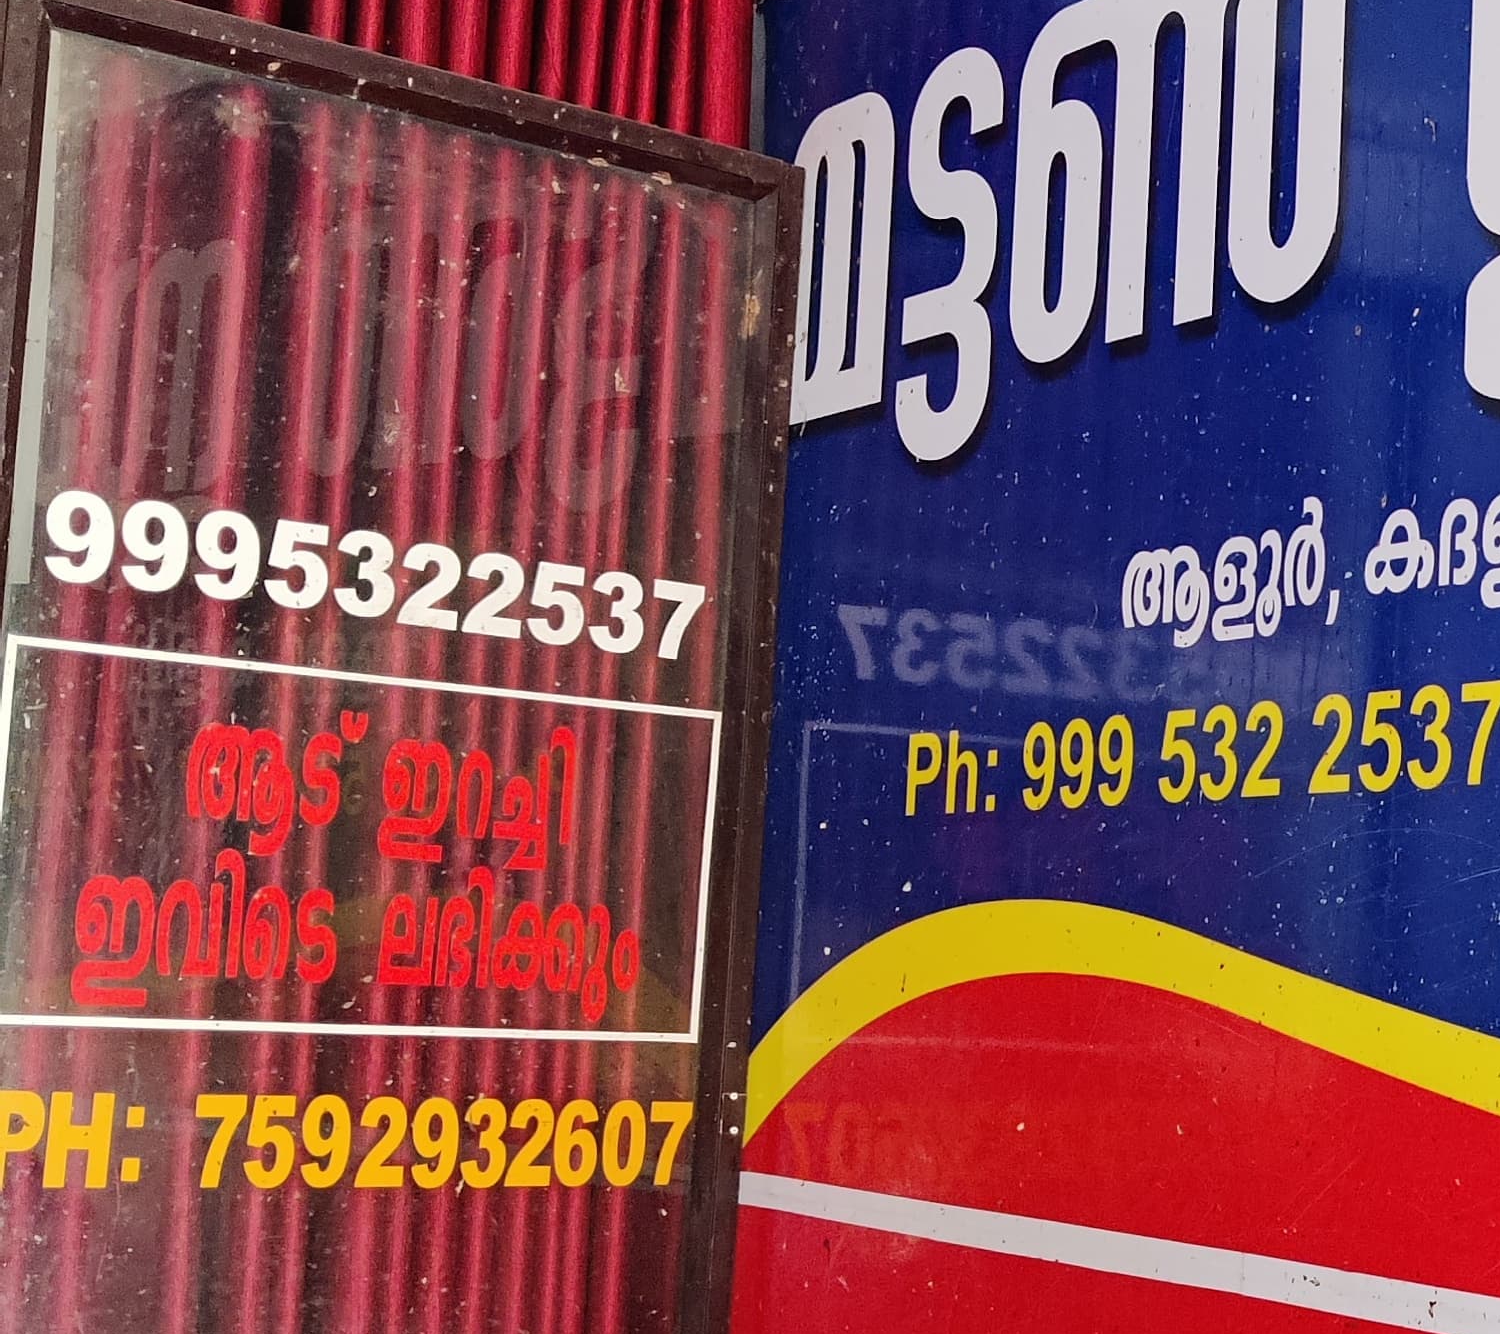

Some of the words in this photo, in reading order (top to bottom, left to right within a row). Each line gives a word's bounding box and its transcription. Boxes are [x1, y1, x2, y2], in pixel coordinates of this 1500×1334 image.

[44, 489, 707, 661] 9995322537
[1121, 496, 1342, 649] ആളൂർ,
[186, 709, 370, 857] ആട്
[377, 725, 577, 871] ഇറച്ചി
[905, 729, 1000, 817] Ph:
[1022, 714, 1135, 811] 999
[1158, 700, 1285, 804] 532
[70, 849, 337, 1008] ഇവിടെ
[376, 865, 641, 1023] ലഭിക്കും
[0, 1089, 146, 1191] PH:
[195, 1093, 696, 1190] 7592932607
